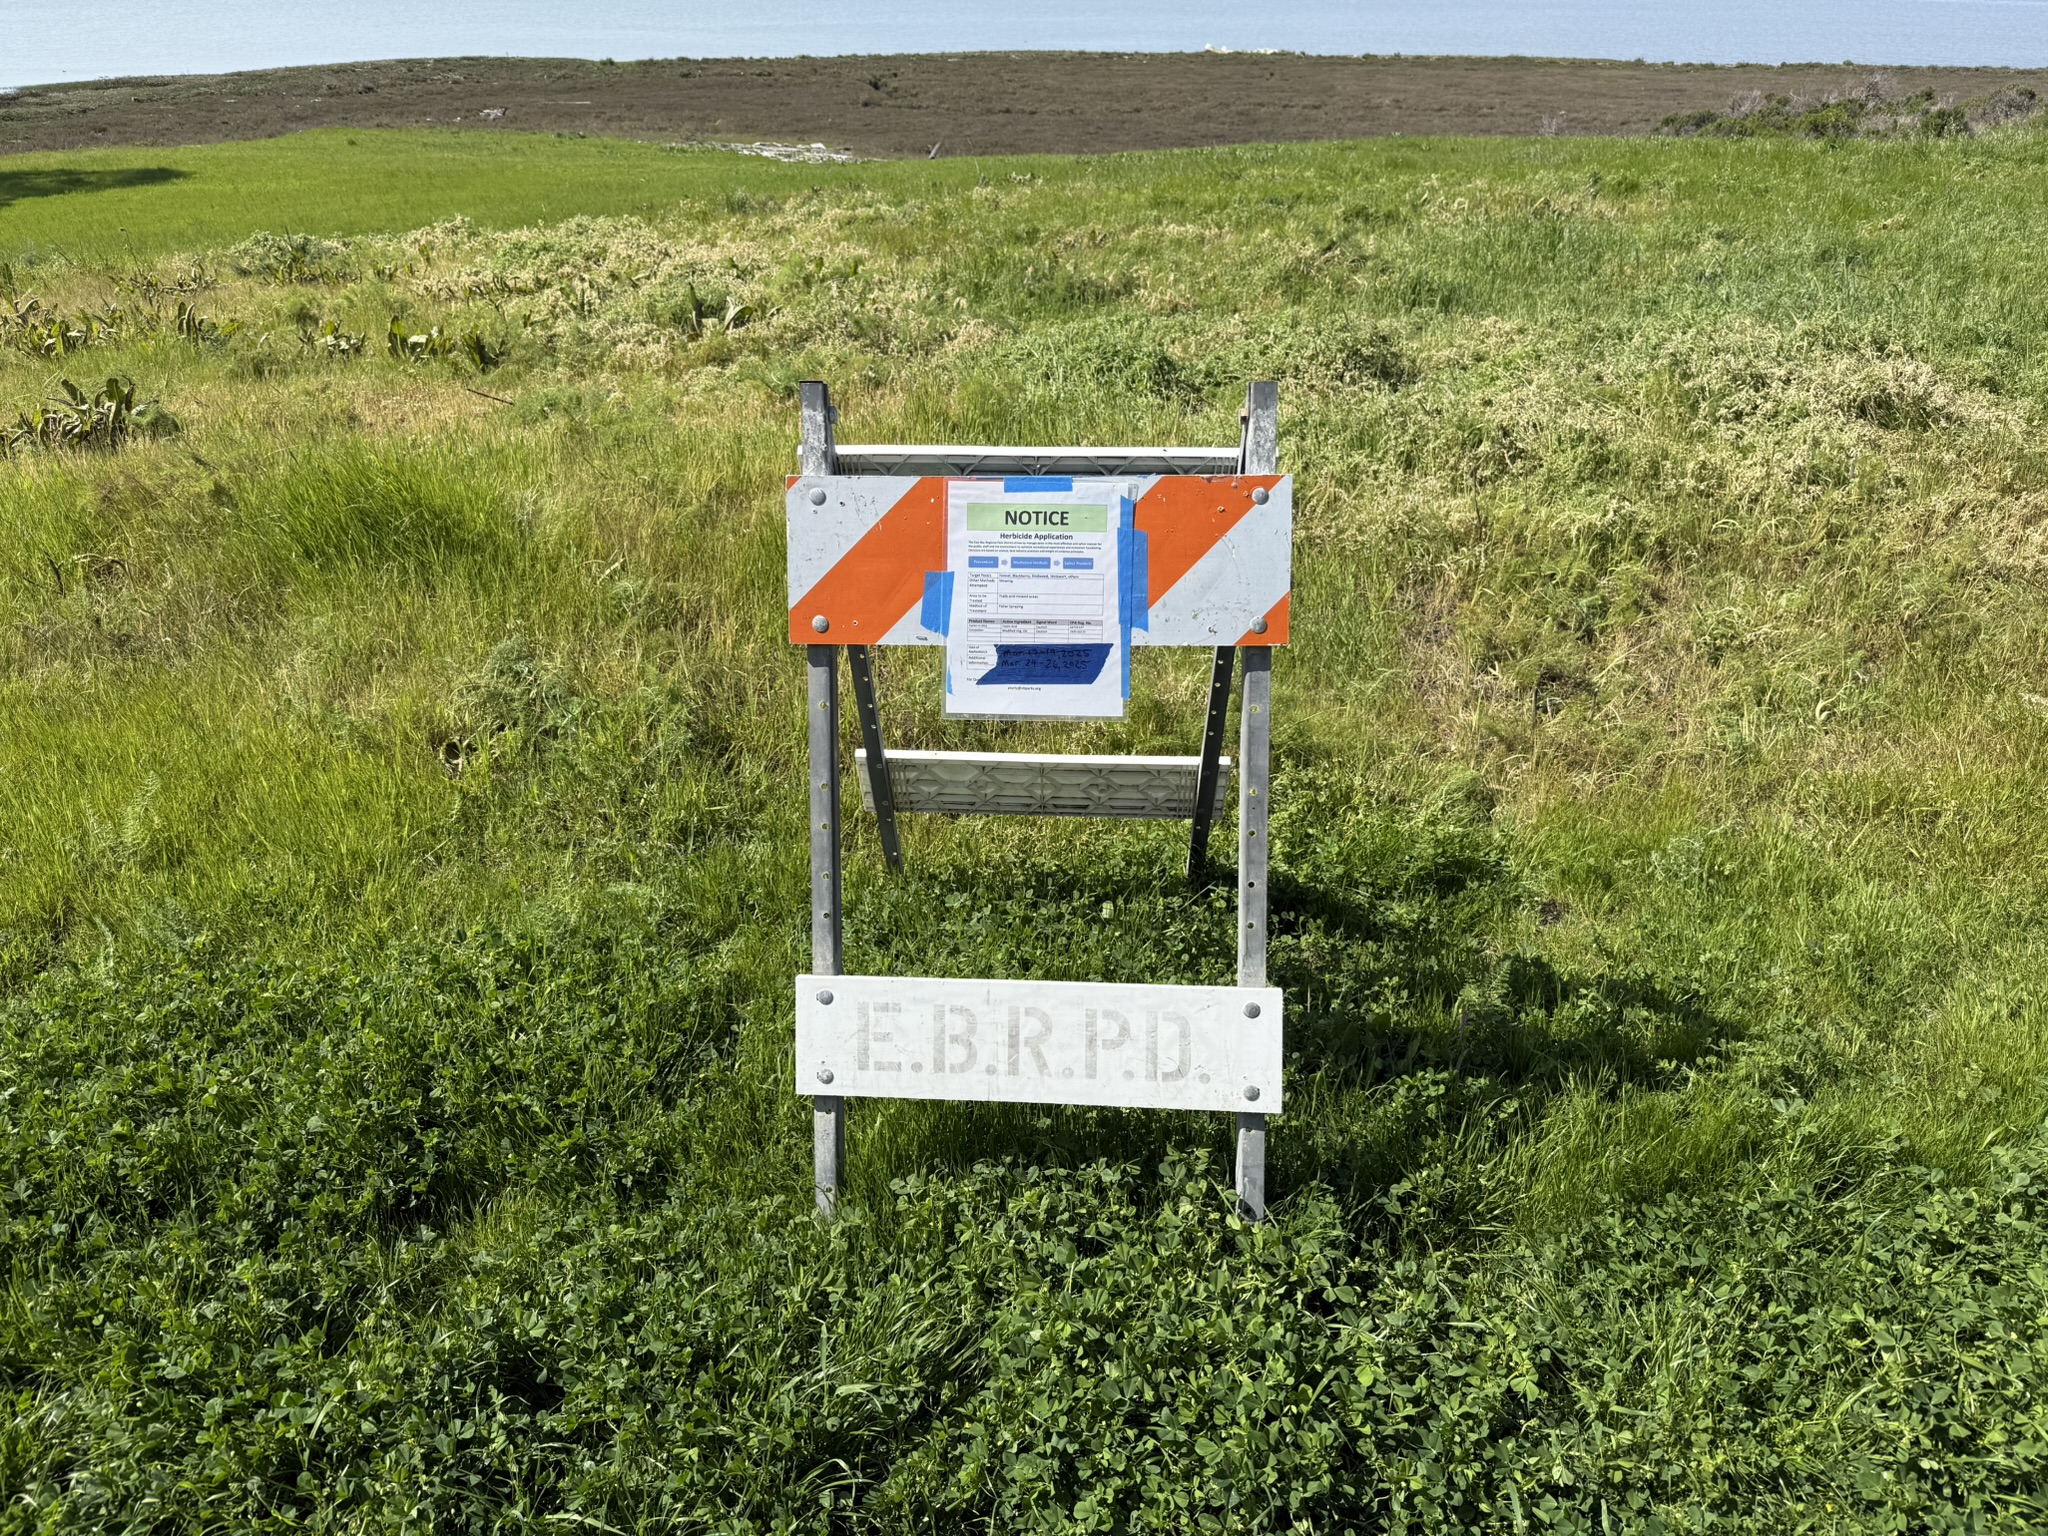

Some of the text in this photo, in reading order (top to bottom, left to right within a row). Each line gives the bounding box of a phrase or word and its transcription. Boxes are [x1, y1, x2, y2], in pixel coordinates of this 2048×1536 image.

[1005, 510, 1069, 526] NOTICE
[1000, 532, 1073, 541] Herbicide Application
[1063, 660, 1091, 669] 2025
[857, 1000, 1211, 1085] E.B.R.P.D.
